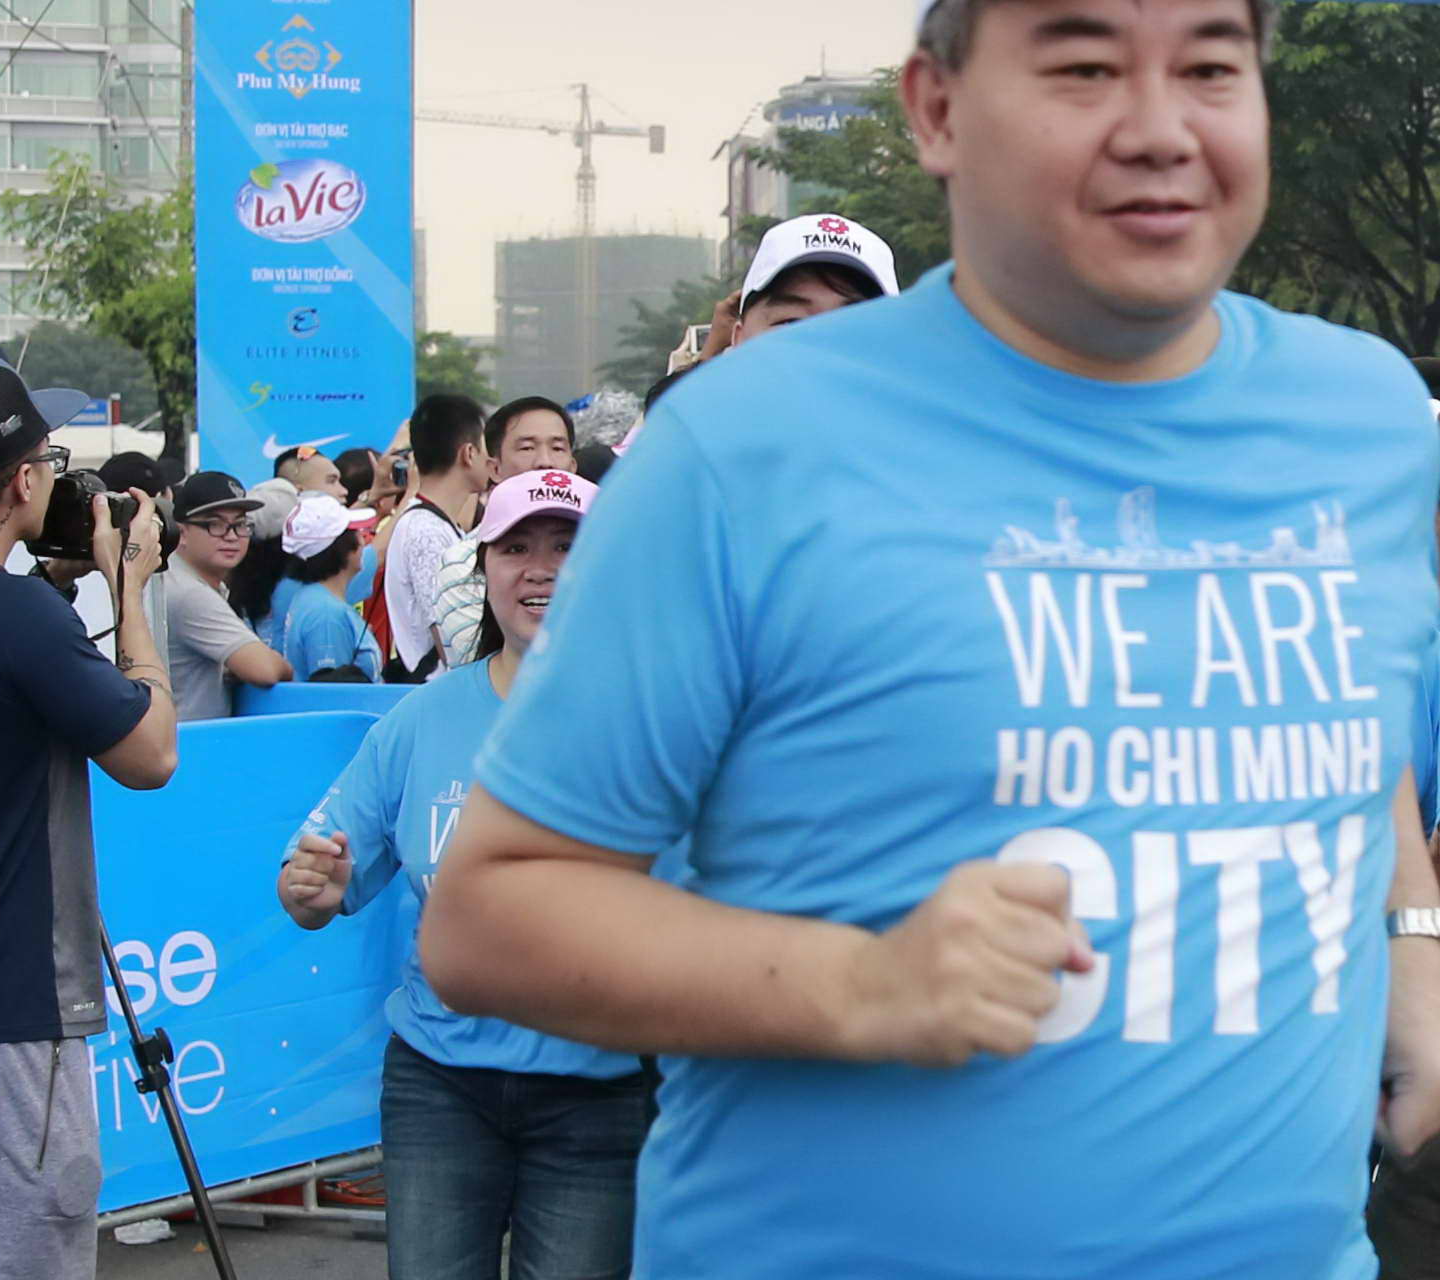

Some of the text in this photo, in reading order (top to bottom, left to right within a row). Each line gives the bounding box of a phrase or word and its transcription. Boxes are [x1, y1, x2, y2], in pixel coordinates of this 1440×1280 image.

[237, 72, 361, 92] Phu My Hung
[802, 233, 862, 254] TAIWAN
[246, 346, 361, 360] ELITE FITNESS
[528, 487, 581, 508] TAIWAN
[986, 570, 1378, 709] WE ARE
[993, 718, 1382, 808] HO CHI MINH
